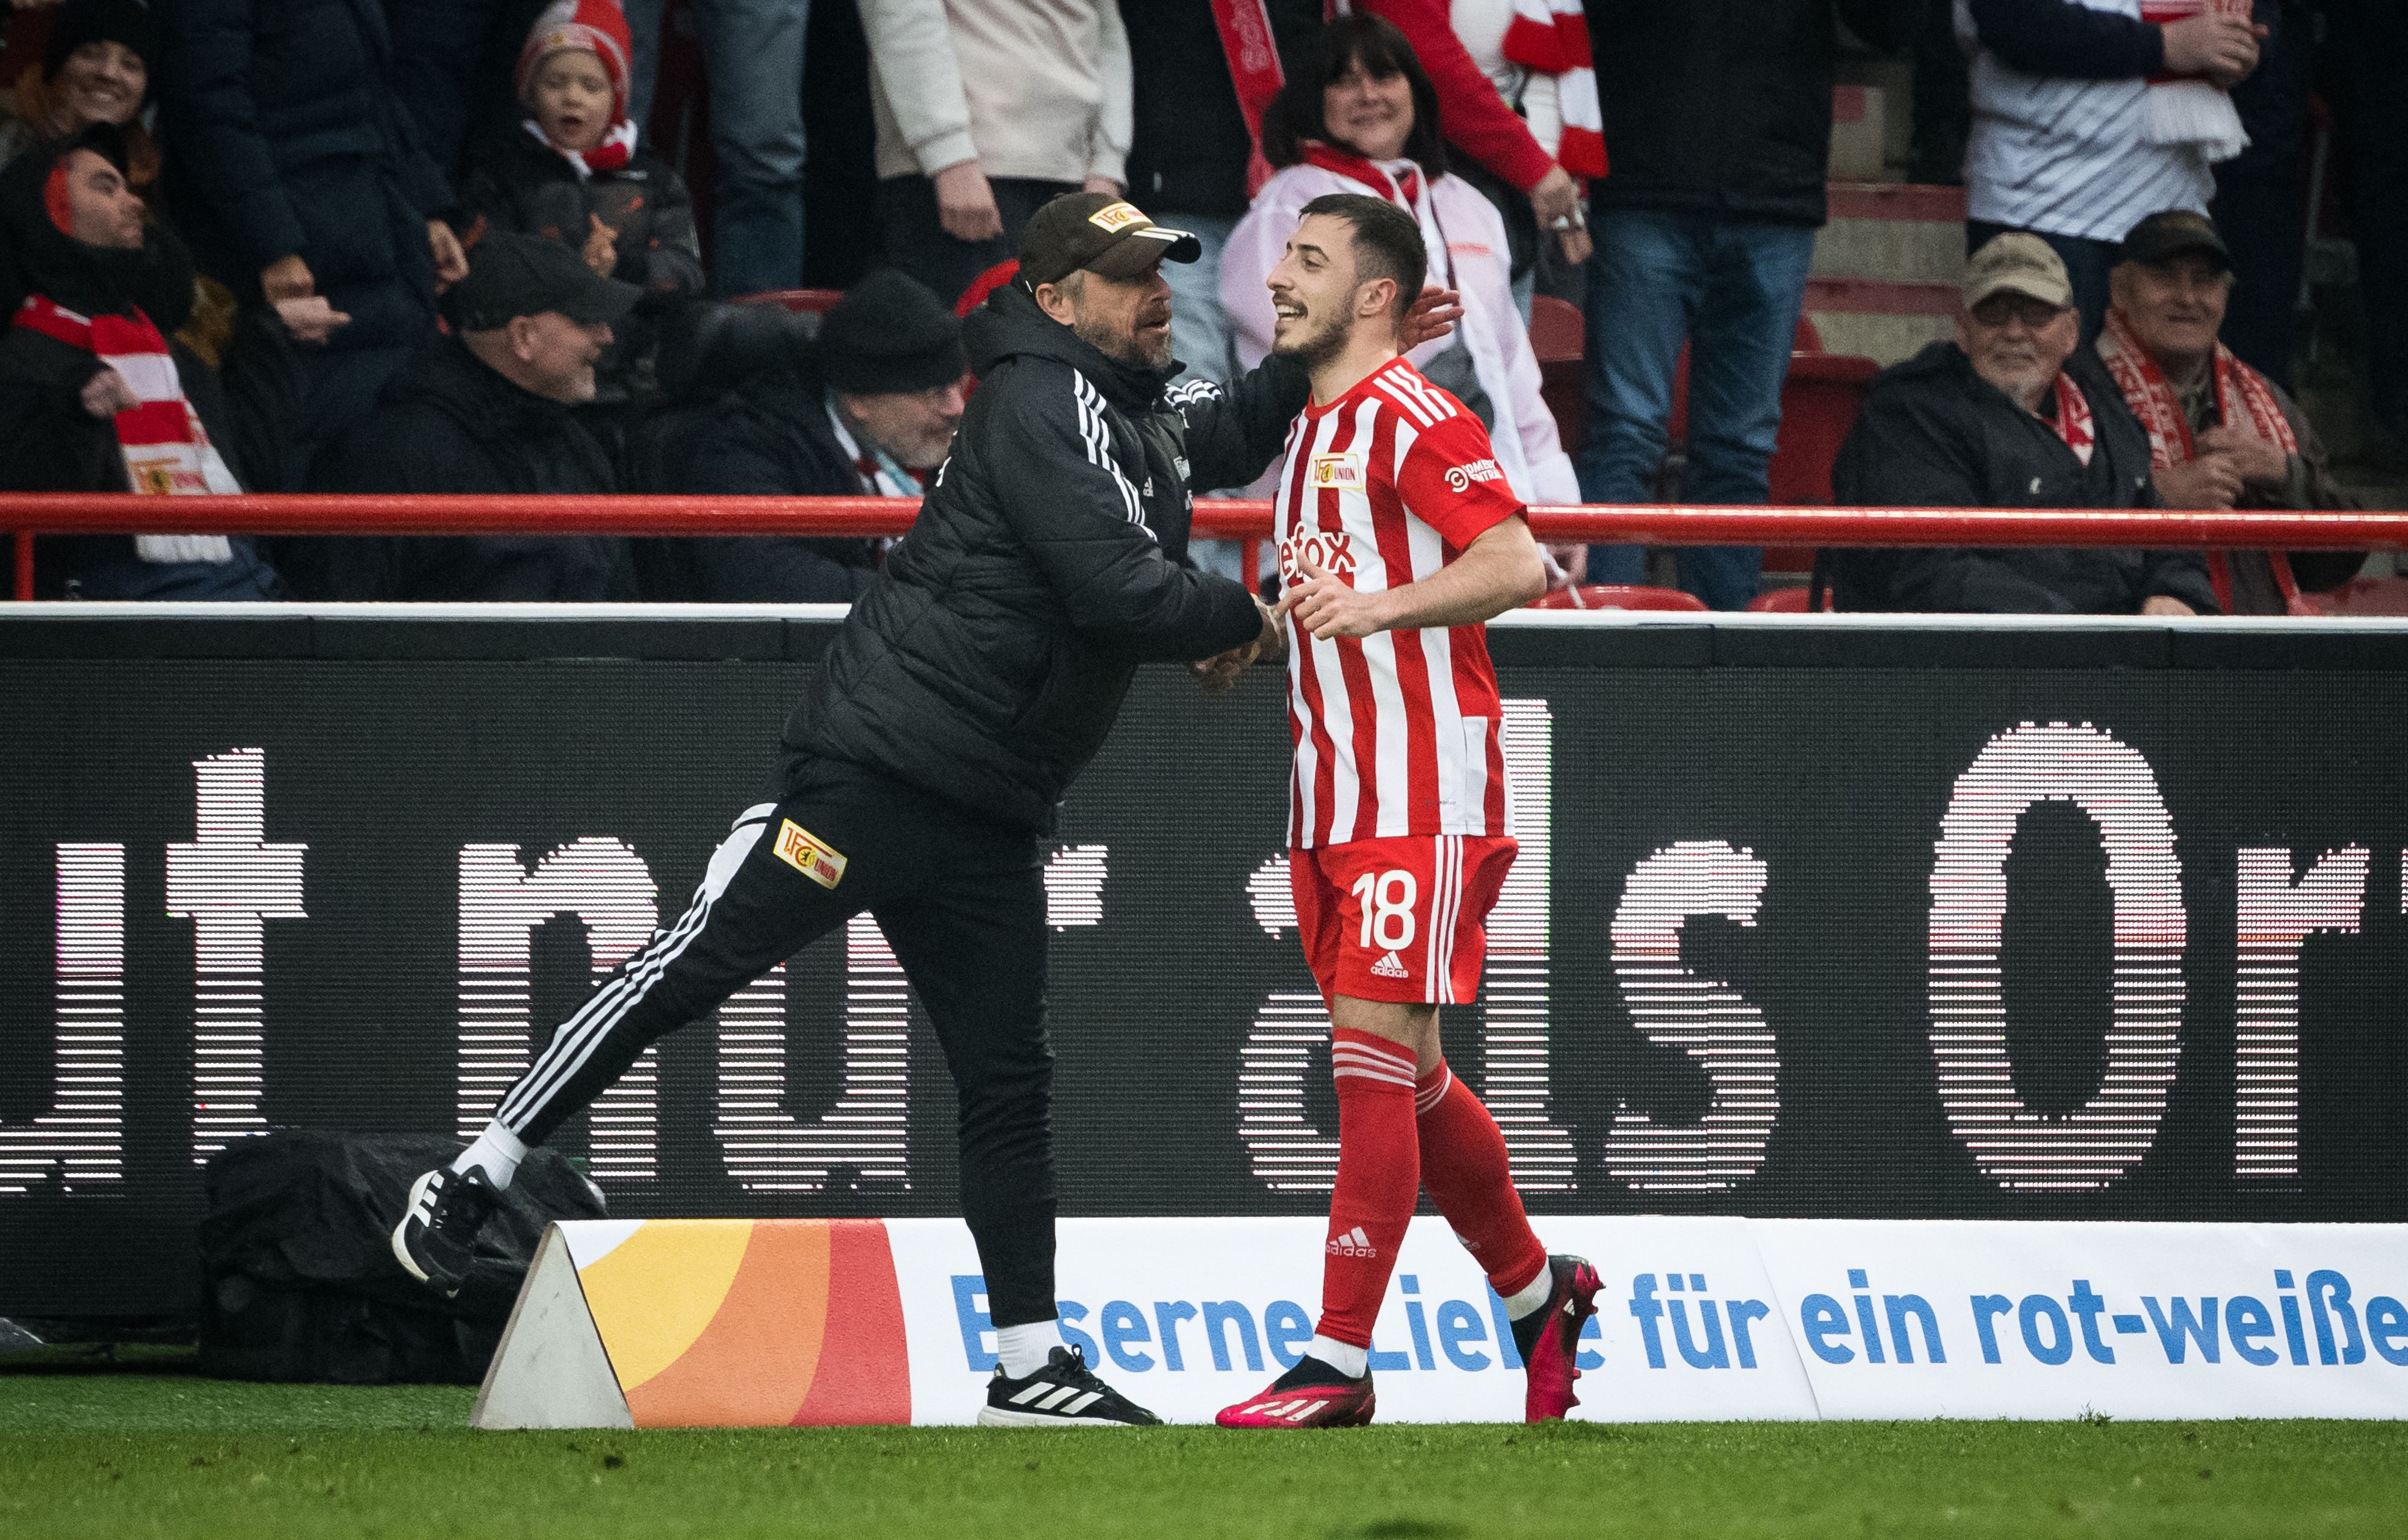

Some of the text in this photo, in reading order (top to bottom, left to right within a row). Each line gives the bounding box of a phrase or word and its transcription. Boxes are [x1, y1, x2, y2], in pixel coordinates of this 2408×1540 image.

[1334, 467, 1355, 480] UNION
[1351, 869, 1417, 950] 18
[1370, 966, 1409, 978] adidas
[1929, 721, 2408, 1191] Or
[1326, 1244, 1377, 1258] adidas
[950, 1275, 1316, 1373] Eserne
[1629, 1273, 1770, 1370] für
[1801, 1268, 1947, 1365] ein
[1970, 1268, 2408, 1366] rot-weiße
